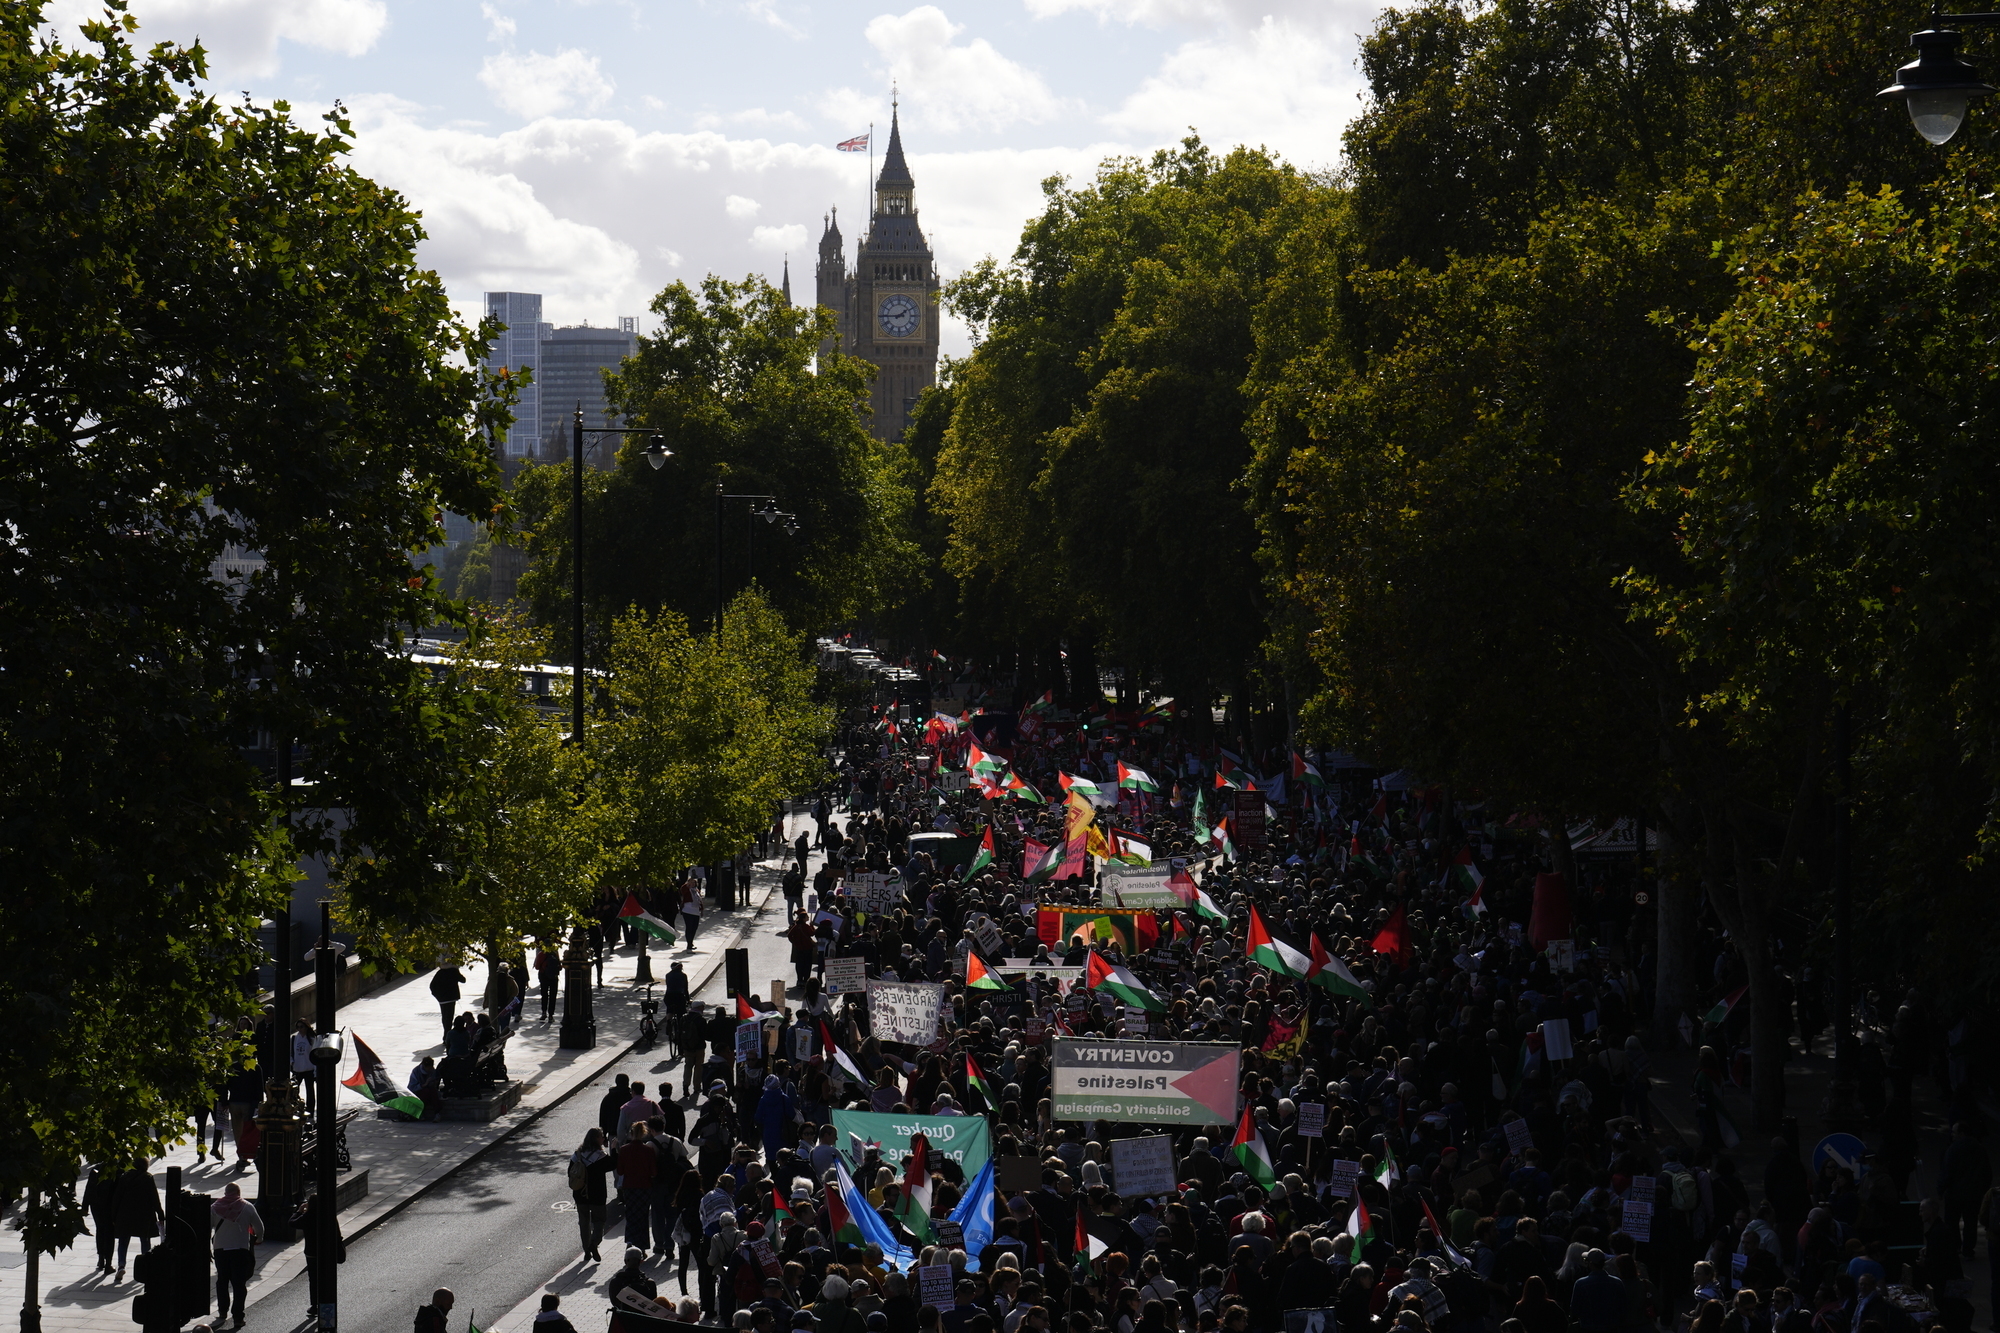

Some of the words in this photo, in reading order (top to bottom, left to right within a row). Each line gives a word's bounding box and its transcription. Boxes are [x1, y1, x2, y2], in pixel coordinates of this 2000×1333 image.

[894, 890, 901, 900] 4
[1149, 956, 1179, 965] Palestine
[986, 993, 1022, 1003] CHRISTI
[738, 1032, 751, 1042] RIGHT
[752, 1030, 758, 1039] TO
[738, 1039, 759, 1050] PROTEST
[941, 1236, 963, 1245] PALESTINE
[923, 1284, 951, 1293] RACISM
